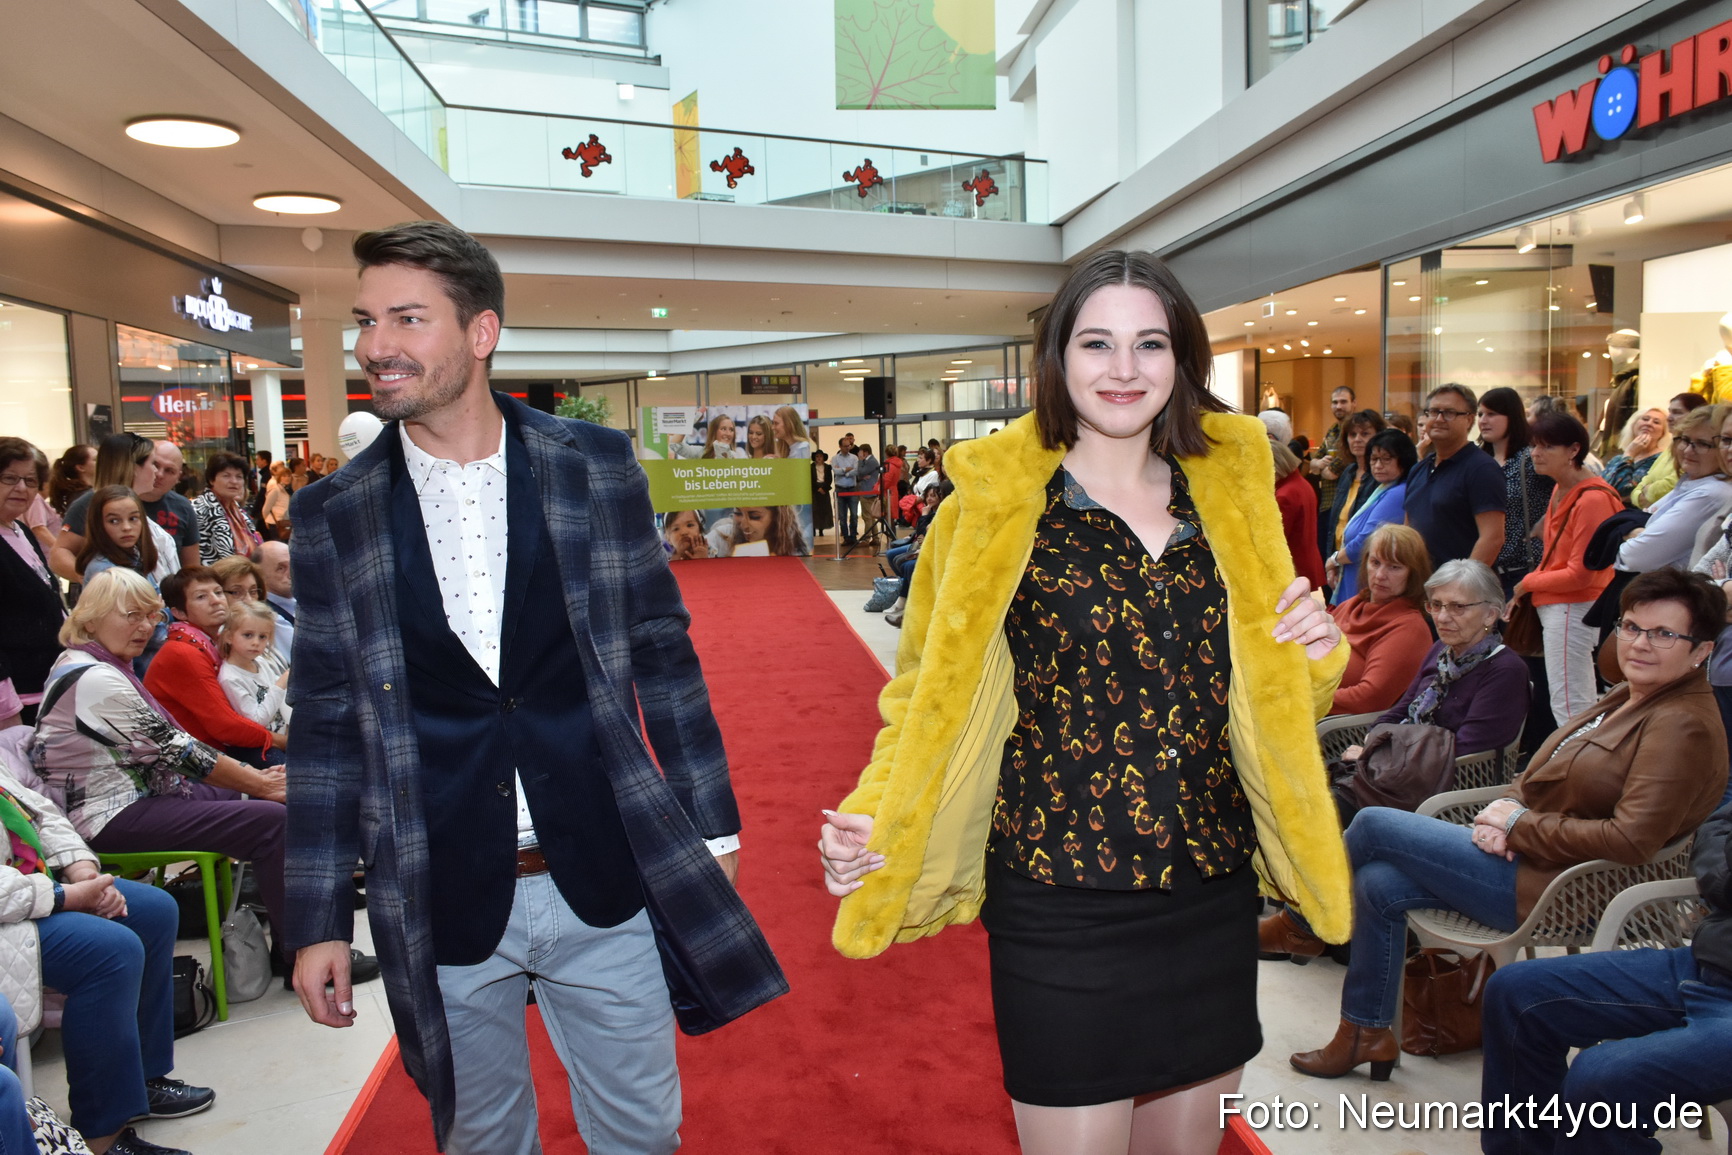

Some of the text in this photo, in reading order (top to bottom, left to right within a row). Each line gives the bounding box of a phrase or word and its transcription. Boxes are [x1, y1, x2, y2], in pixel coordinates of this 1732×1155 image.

[673, 466, 773, 479] Von Shoppingtour
[684, 479, 761, 491] bis Leben pur.
